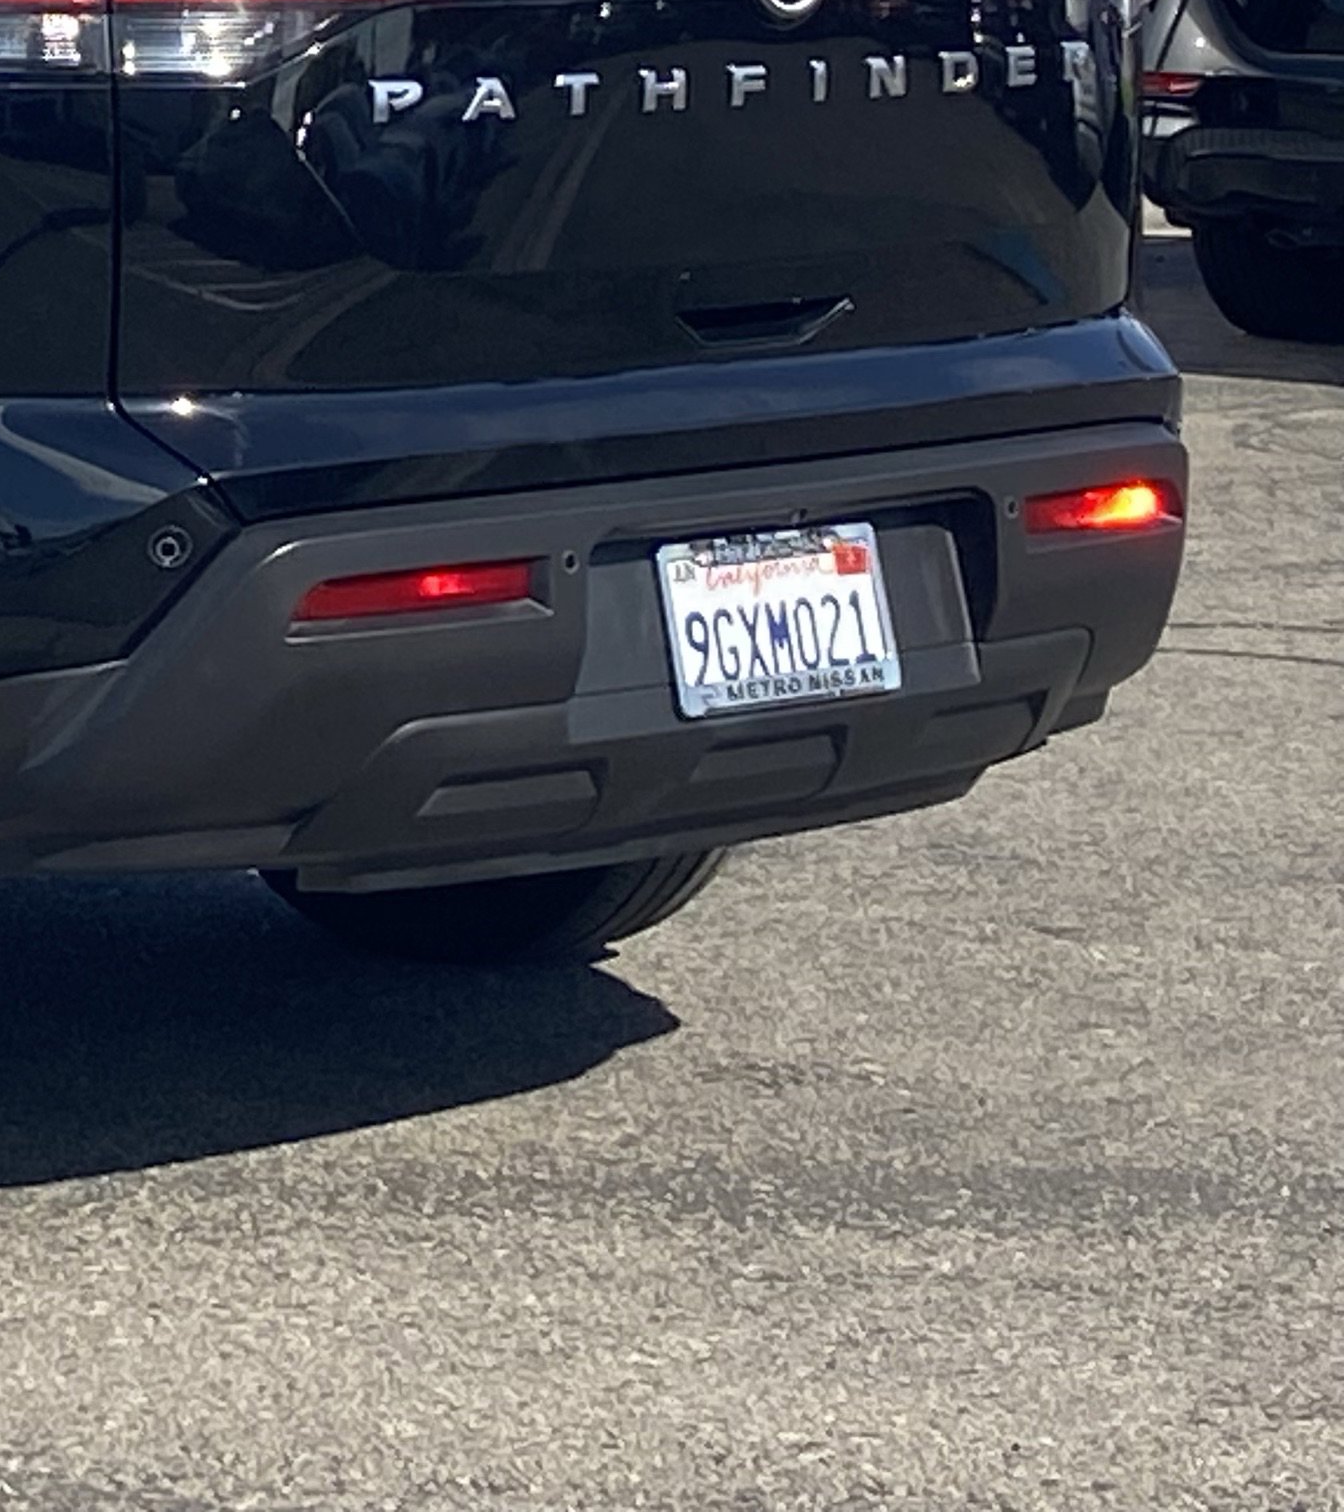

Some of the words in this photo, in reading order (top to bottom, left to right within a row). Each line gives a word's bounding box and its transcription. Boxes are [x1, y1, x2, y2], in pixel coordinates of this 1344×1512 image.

[368, 41, 1093, 124] PATHFINDER
[706, 556, 820, 595] California
[685, 590, 877, 687] 9GXM021
[727, 678, 802, 701] METRO
[809, 667, 885, 692] NISSAN
